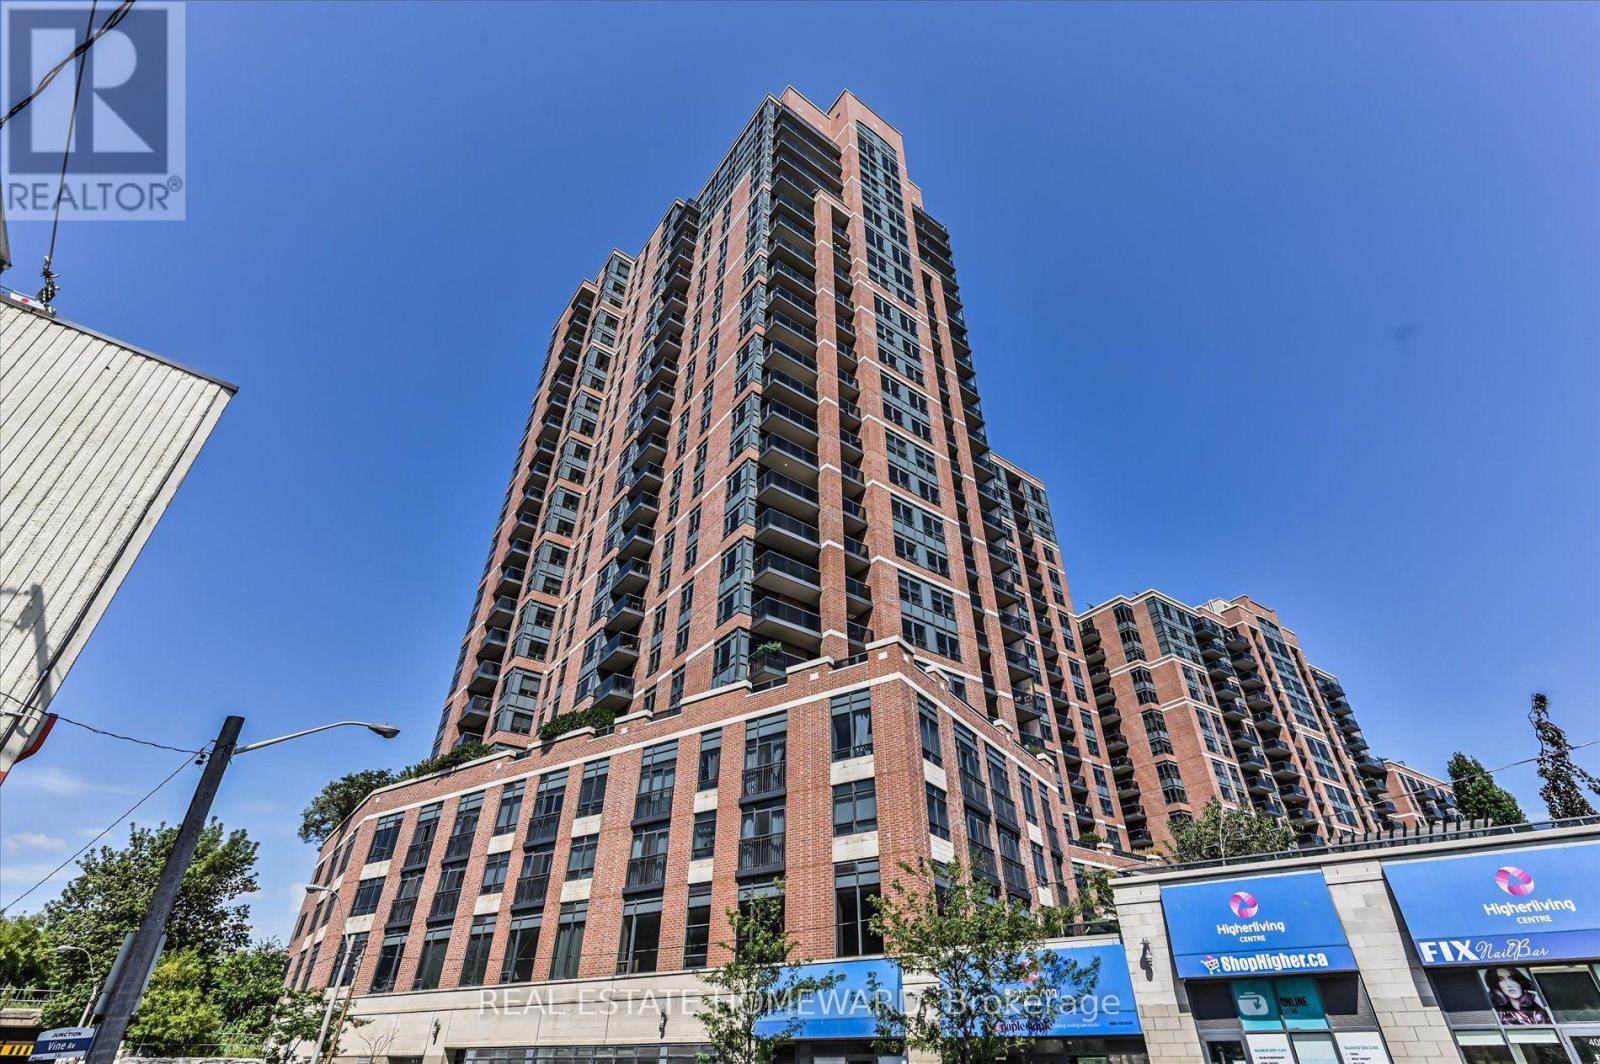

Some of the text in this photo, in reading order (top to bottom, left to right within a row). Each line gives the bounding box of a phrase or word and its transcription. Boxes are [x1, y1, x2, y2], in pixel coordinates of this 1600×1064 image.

[1483, 898, 1576, 917] Higherliving
[1516, 914, 1553, 925] CENTRE
[1216, 920, 1286, 936] Higherliving
[1239, 934, 1266, 943] CENTRE
[1418, 939, 1480, 963] FIX
[1220, 952, 1329, 973] ShopHigher.ca
[47, 1041, 77, 1051] Vine Av
